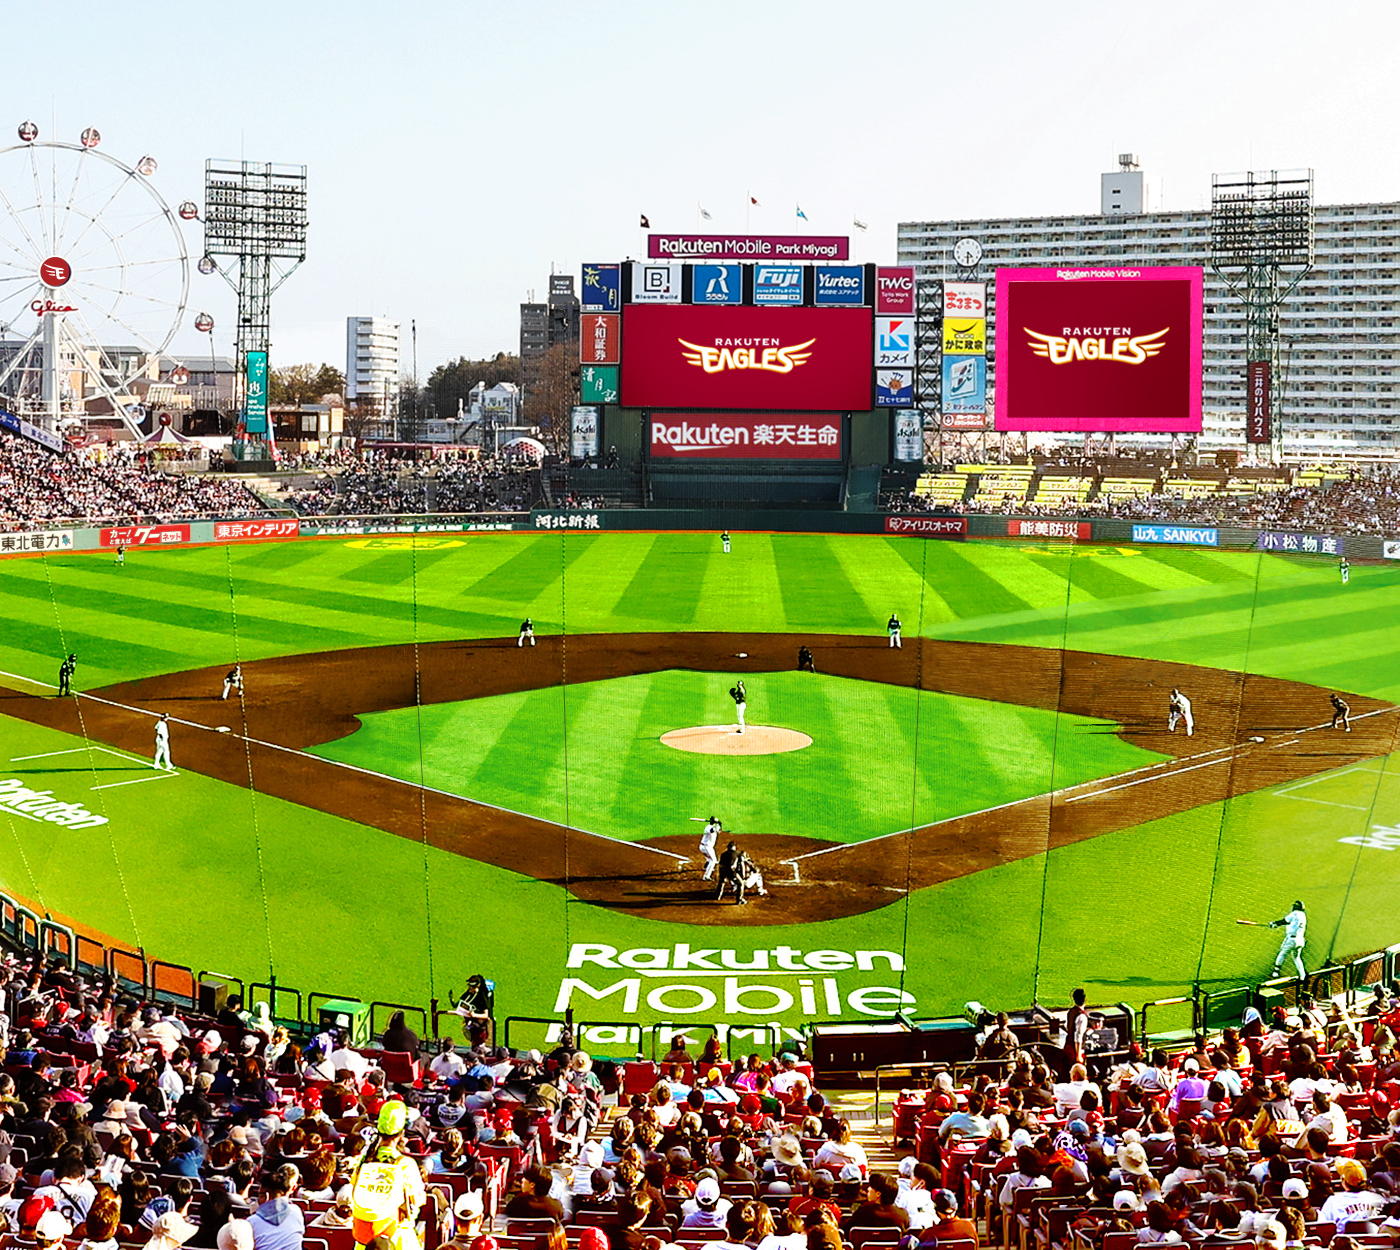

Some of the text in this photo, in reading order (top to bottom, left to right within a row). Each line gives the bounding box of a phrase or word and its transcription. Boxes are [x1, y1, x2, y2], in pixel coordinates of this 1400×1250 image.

[659, 238, 838, 257] Rakuten Mobile Park Miyagi
[757, 268, 800, 287] Fuji
[819, 274, 860, 287] Yurtec
[1056, 269, 1140, 279] Rakuten Mobile Vision
[878, 277, 913, 290] TWG
[31, 300, 79, 317] Glico
[945, 291, 982, 310] まるまつ
[595, 315, 607, 361] 大和証券
[1063, 327, 1132, 335] RAKUTEN
[715, 338, 780, 346] RAKUTEN
[1041, 334, 1154, 365] EAGLES
[694, 345, 802, 373] EAGLES
[880, 353, 909, 363] カメイ
[1254, 367, 1263, 438] 三井のリハウス
[652, 422, 838, 448] Rakuten 楽天生命
[218, 521, 296, 538] 東京インテリア
[535, 514, 600, 529] 河北新報
[901, 519, 963, 532] アイリスオーヤマ
[1020, 521, 1078, 538] 能美防災
[1, 534, 60, 551] 東北電力
[162, 533, 182, 541] ネット
[1133, 527, 1216, 545] 山九 SANKYU
[1264, 534, 1337, 554] 小松物産
[565, 943, 907, 976] Rakuten
[553, 978, 917, 1017] Mobile
